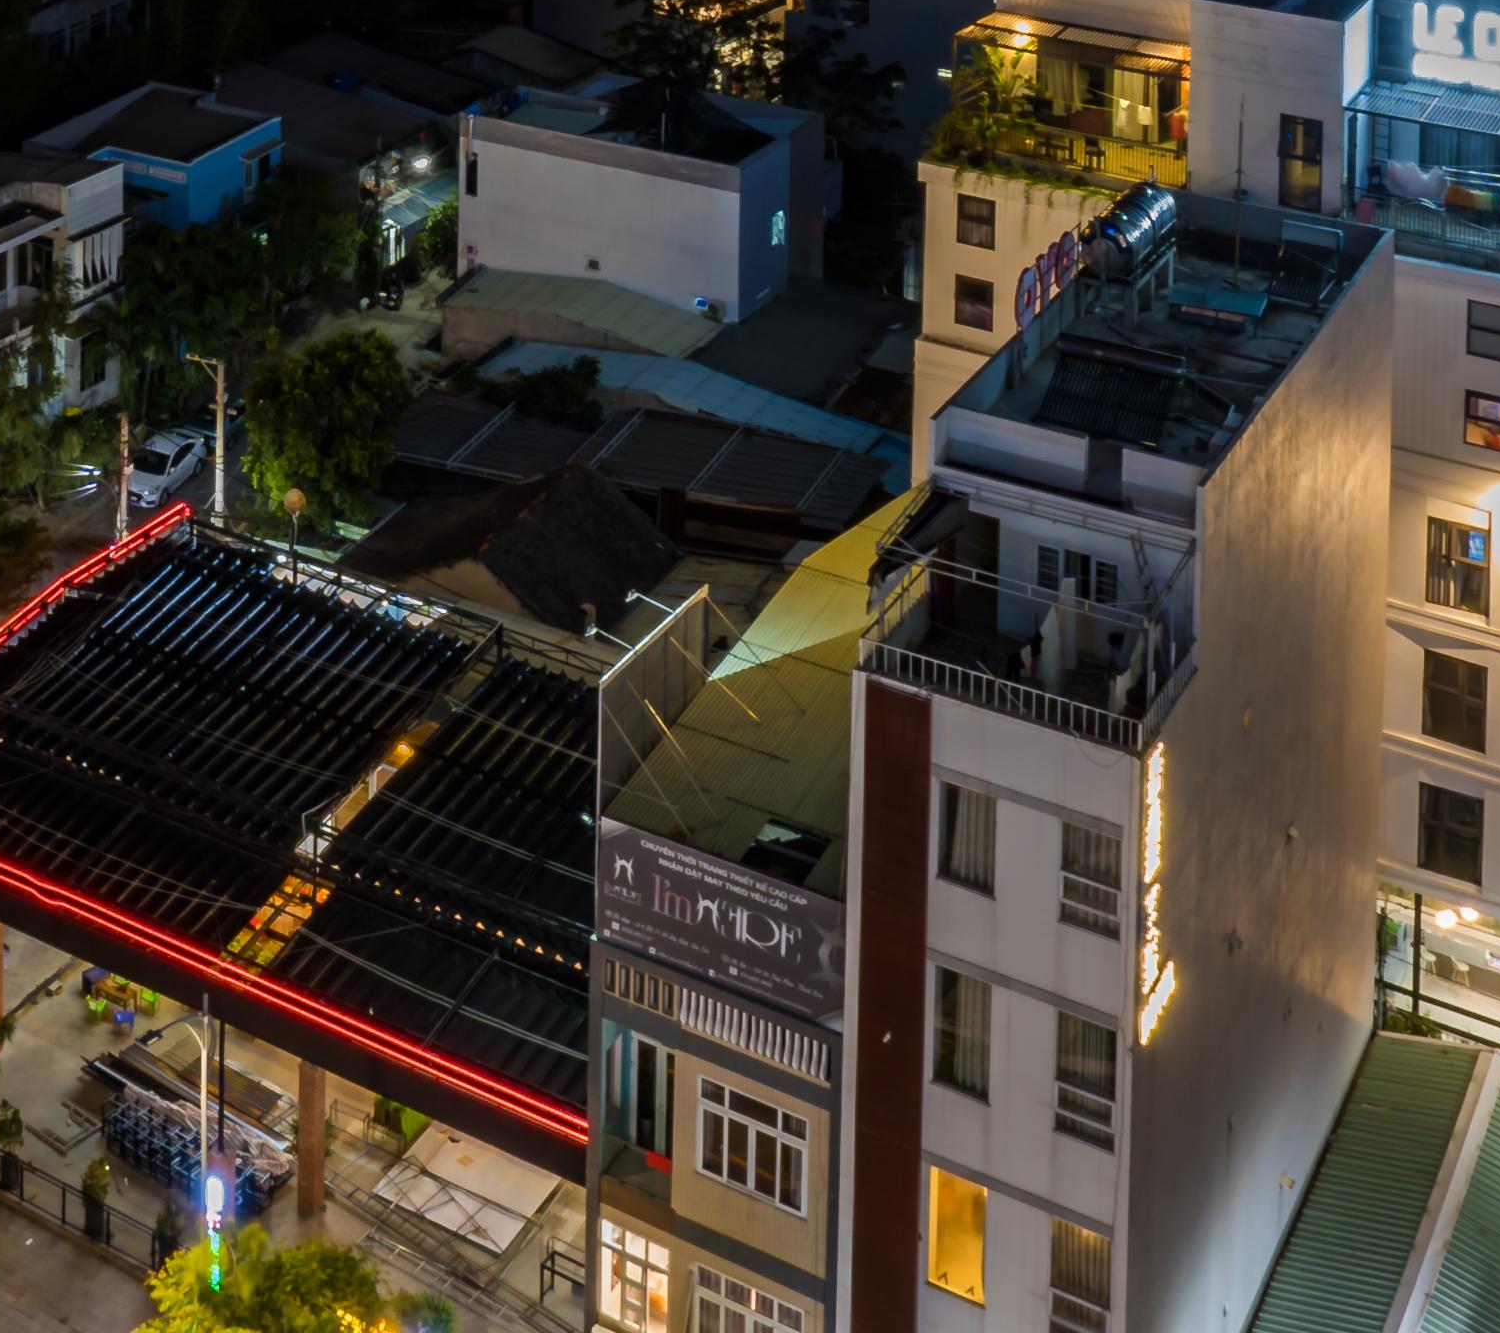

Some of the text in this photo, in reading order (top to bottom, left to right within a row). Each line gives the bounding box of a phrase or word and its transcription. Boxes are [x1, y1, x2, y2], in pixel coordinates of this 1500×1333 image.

[640, 839, 675, 860] CHUYÊN
[697, 858, 728, 878] TRANG
[767, 884, 788, 900] CAO
[704, 874, 725, 889] MAY
[725, 880, 749, 897] THEO
